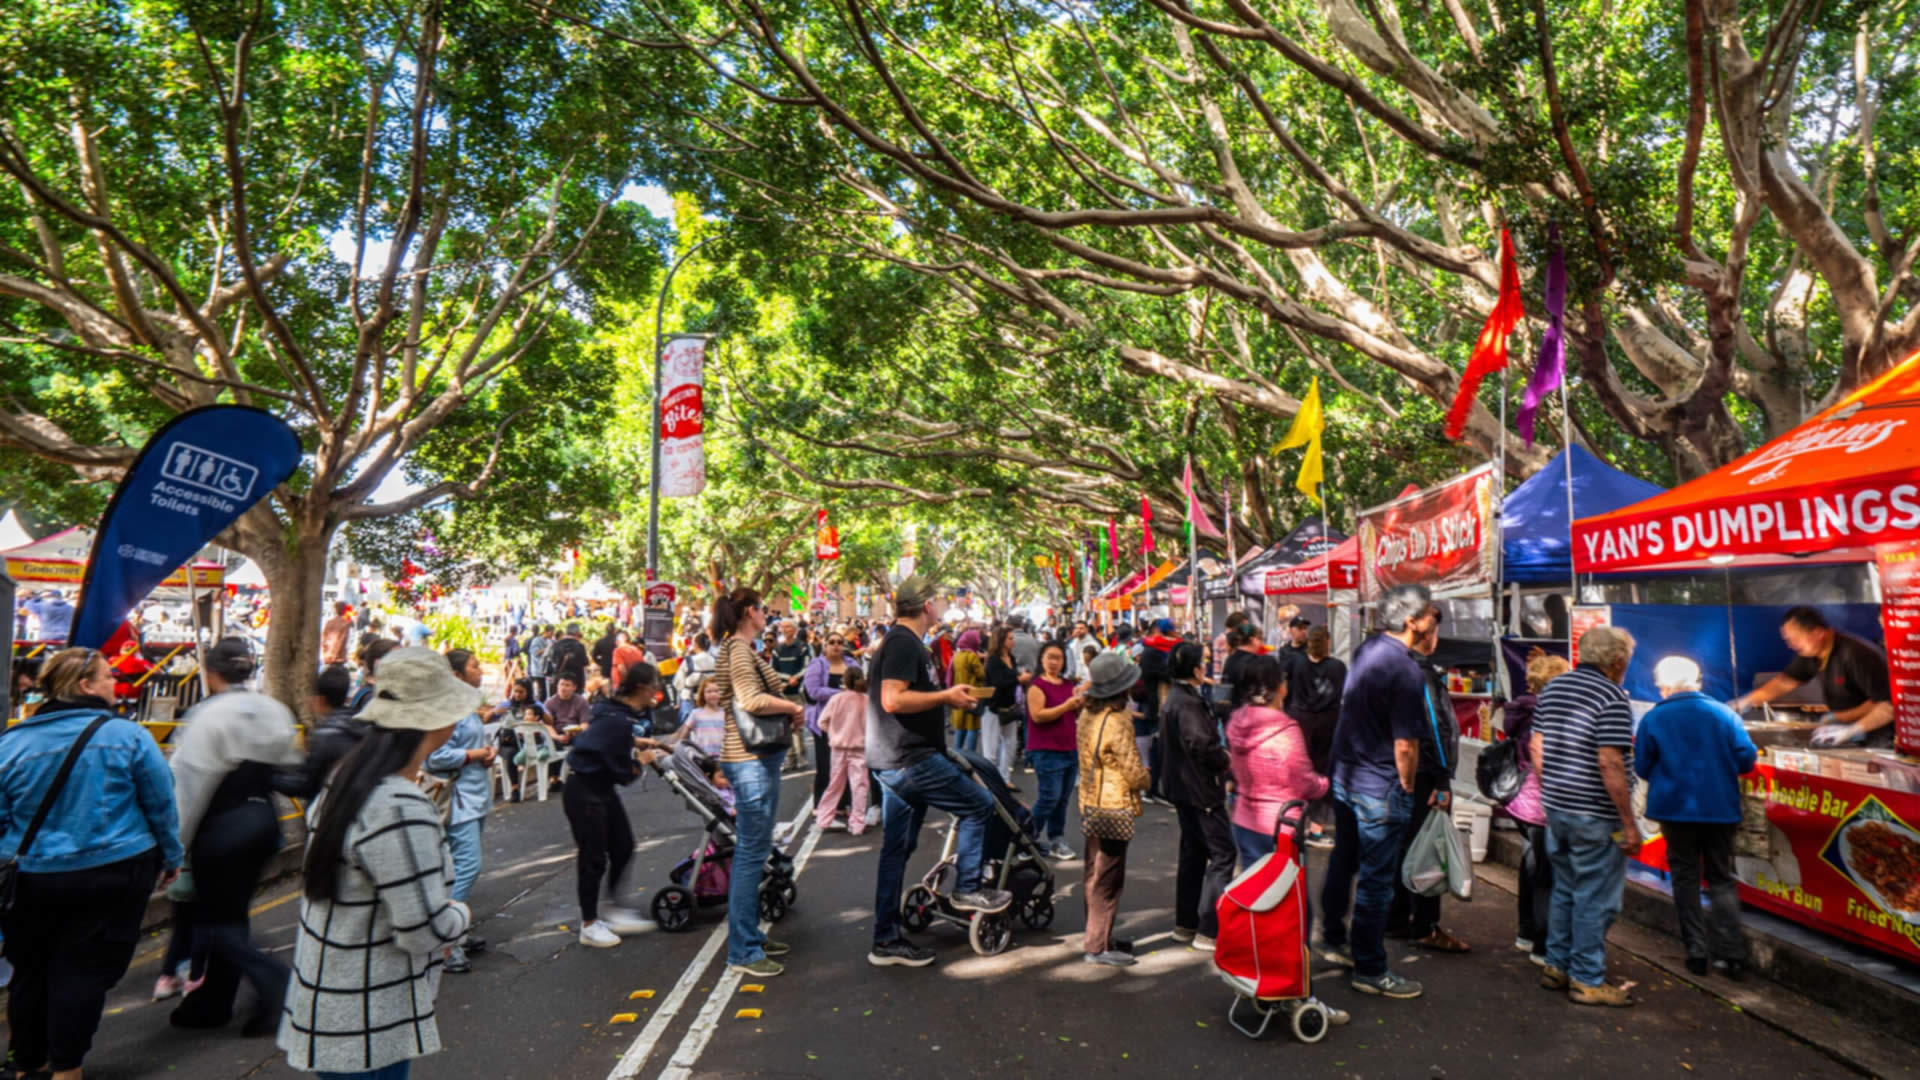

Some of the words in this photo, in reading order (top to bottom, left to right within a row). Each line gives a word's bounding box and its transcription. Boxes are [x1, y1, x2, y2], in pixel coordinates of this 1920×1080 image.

[150, 492, 200, 517] Toilets
[152, 480, 235, 513] Accessible
[1377, 533, 1408, 572] Chips
[1427, 520, 1439, 556] A
[1441, 510, 1477, 555] Stick
[1583, 521, 1665, 564] YAN'S
[1672, 484, 1920, 552] DUMPLINGS
[1769, 778, 1819, 813] Noodle
[1820, 789, 1850, 819] Bar
[1756, 871, 1790, 902] Pork
[1793, 884, 1823, 914] Bun
[1847, 896, 1888, 929] Fried
